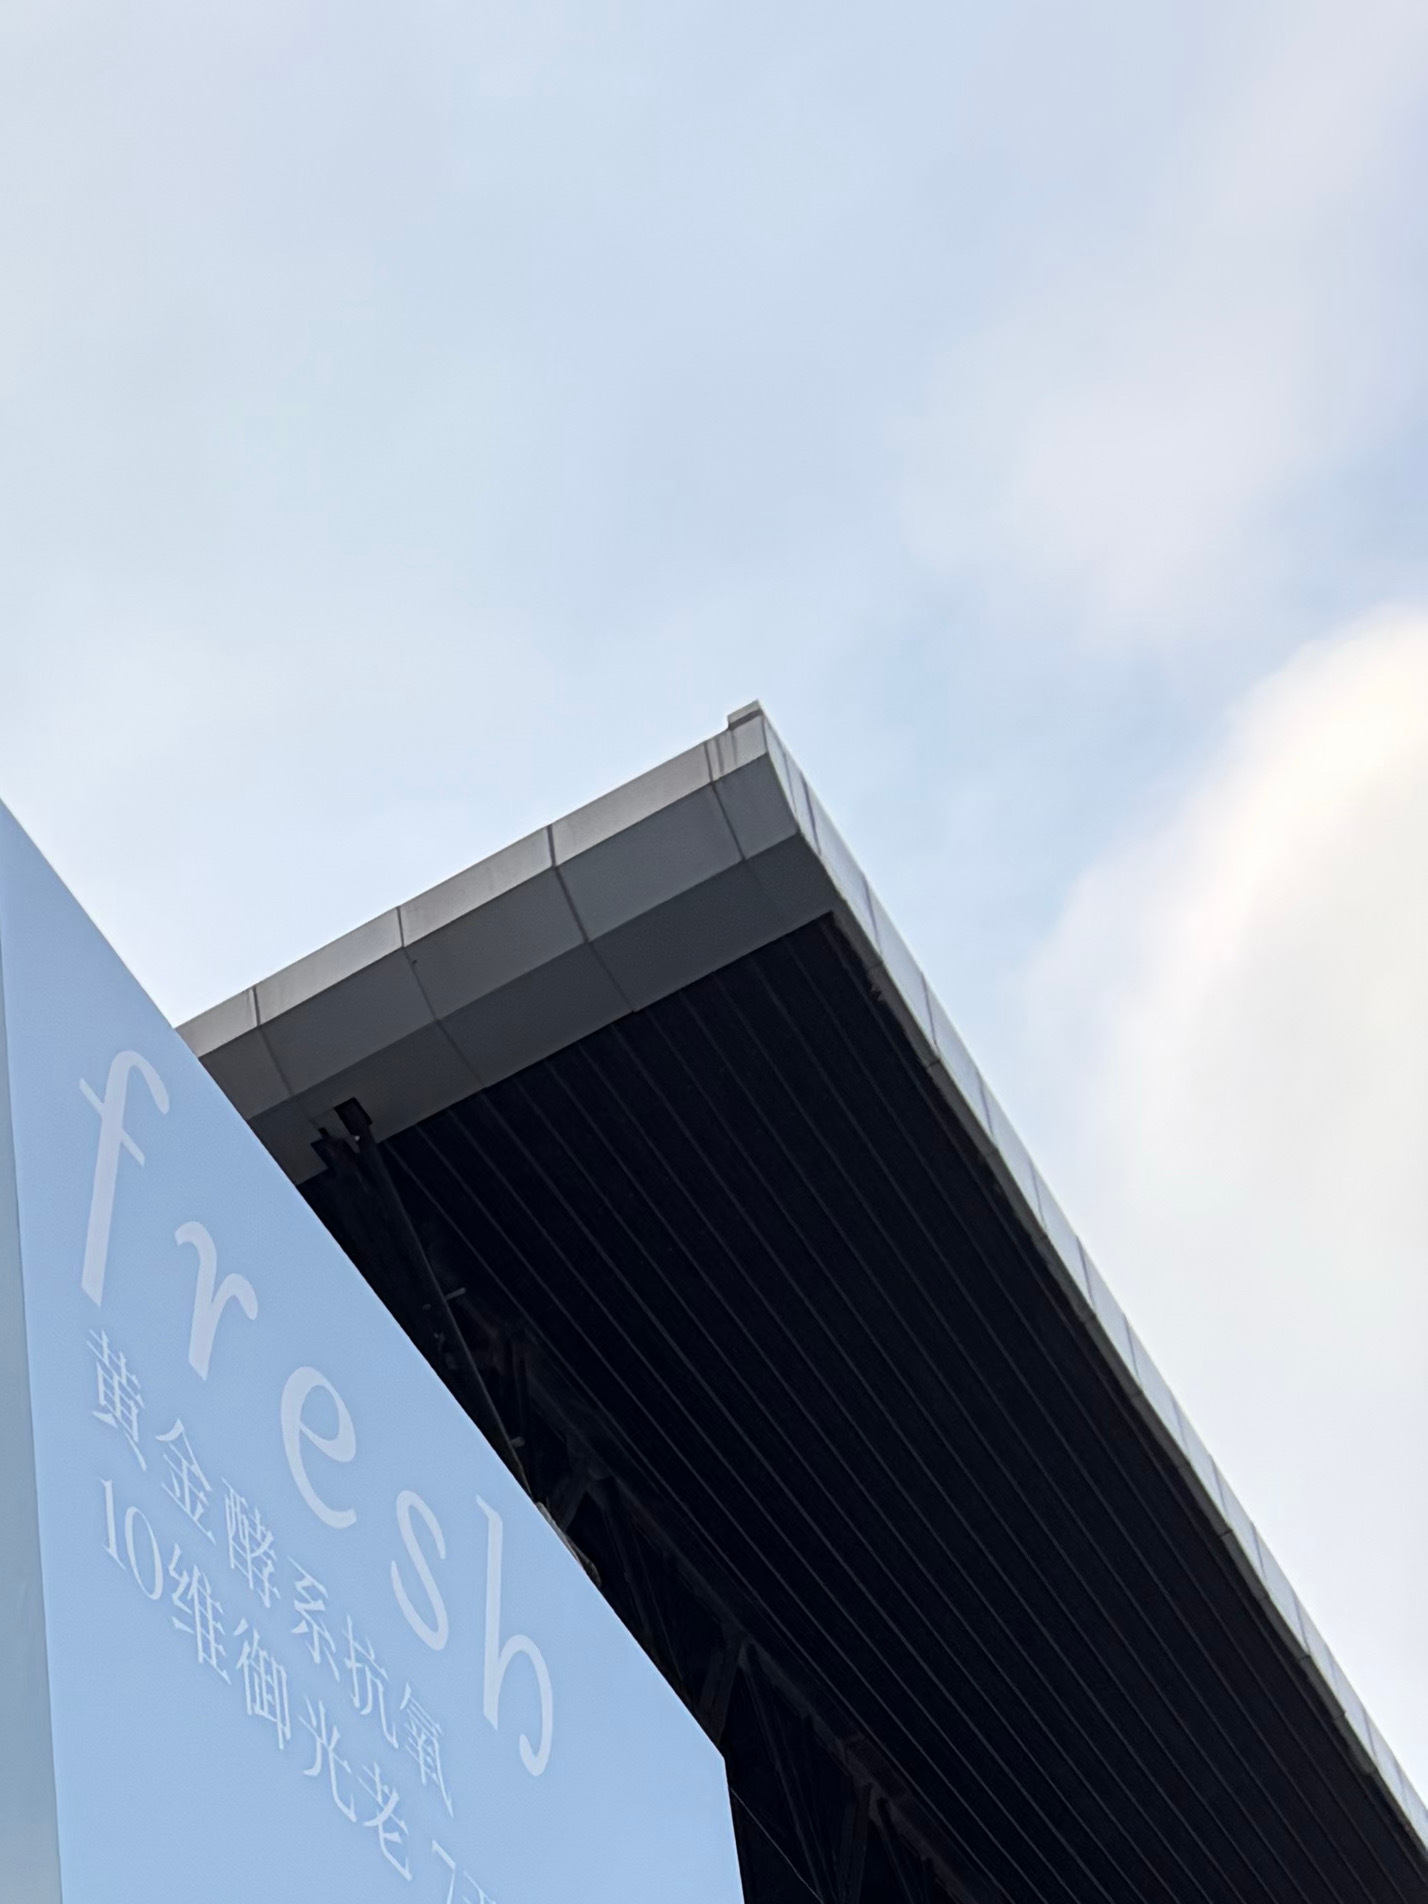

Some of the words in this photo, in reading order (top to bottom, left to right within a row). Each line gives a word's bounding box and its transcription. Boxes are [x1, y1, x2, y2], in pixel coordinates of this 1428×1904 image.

[78, 1050, 553, 1776] fresh
[85, 1328, 454, 1818] 黄金酵系抗氧
[100, 1478, 412, 1881] 10维御光老
